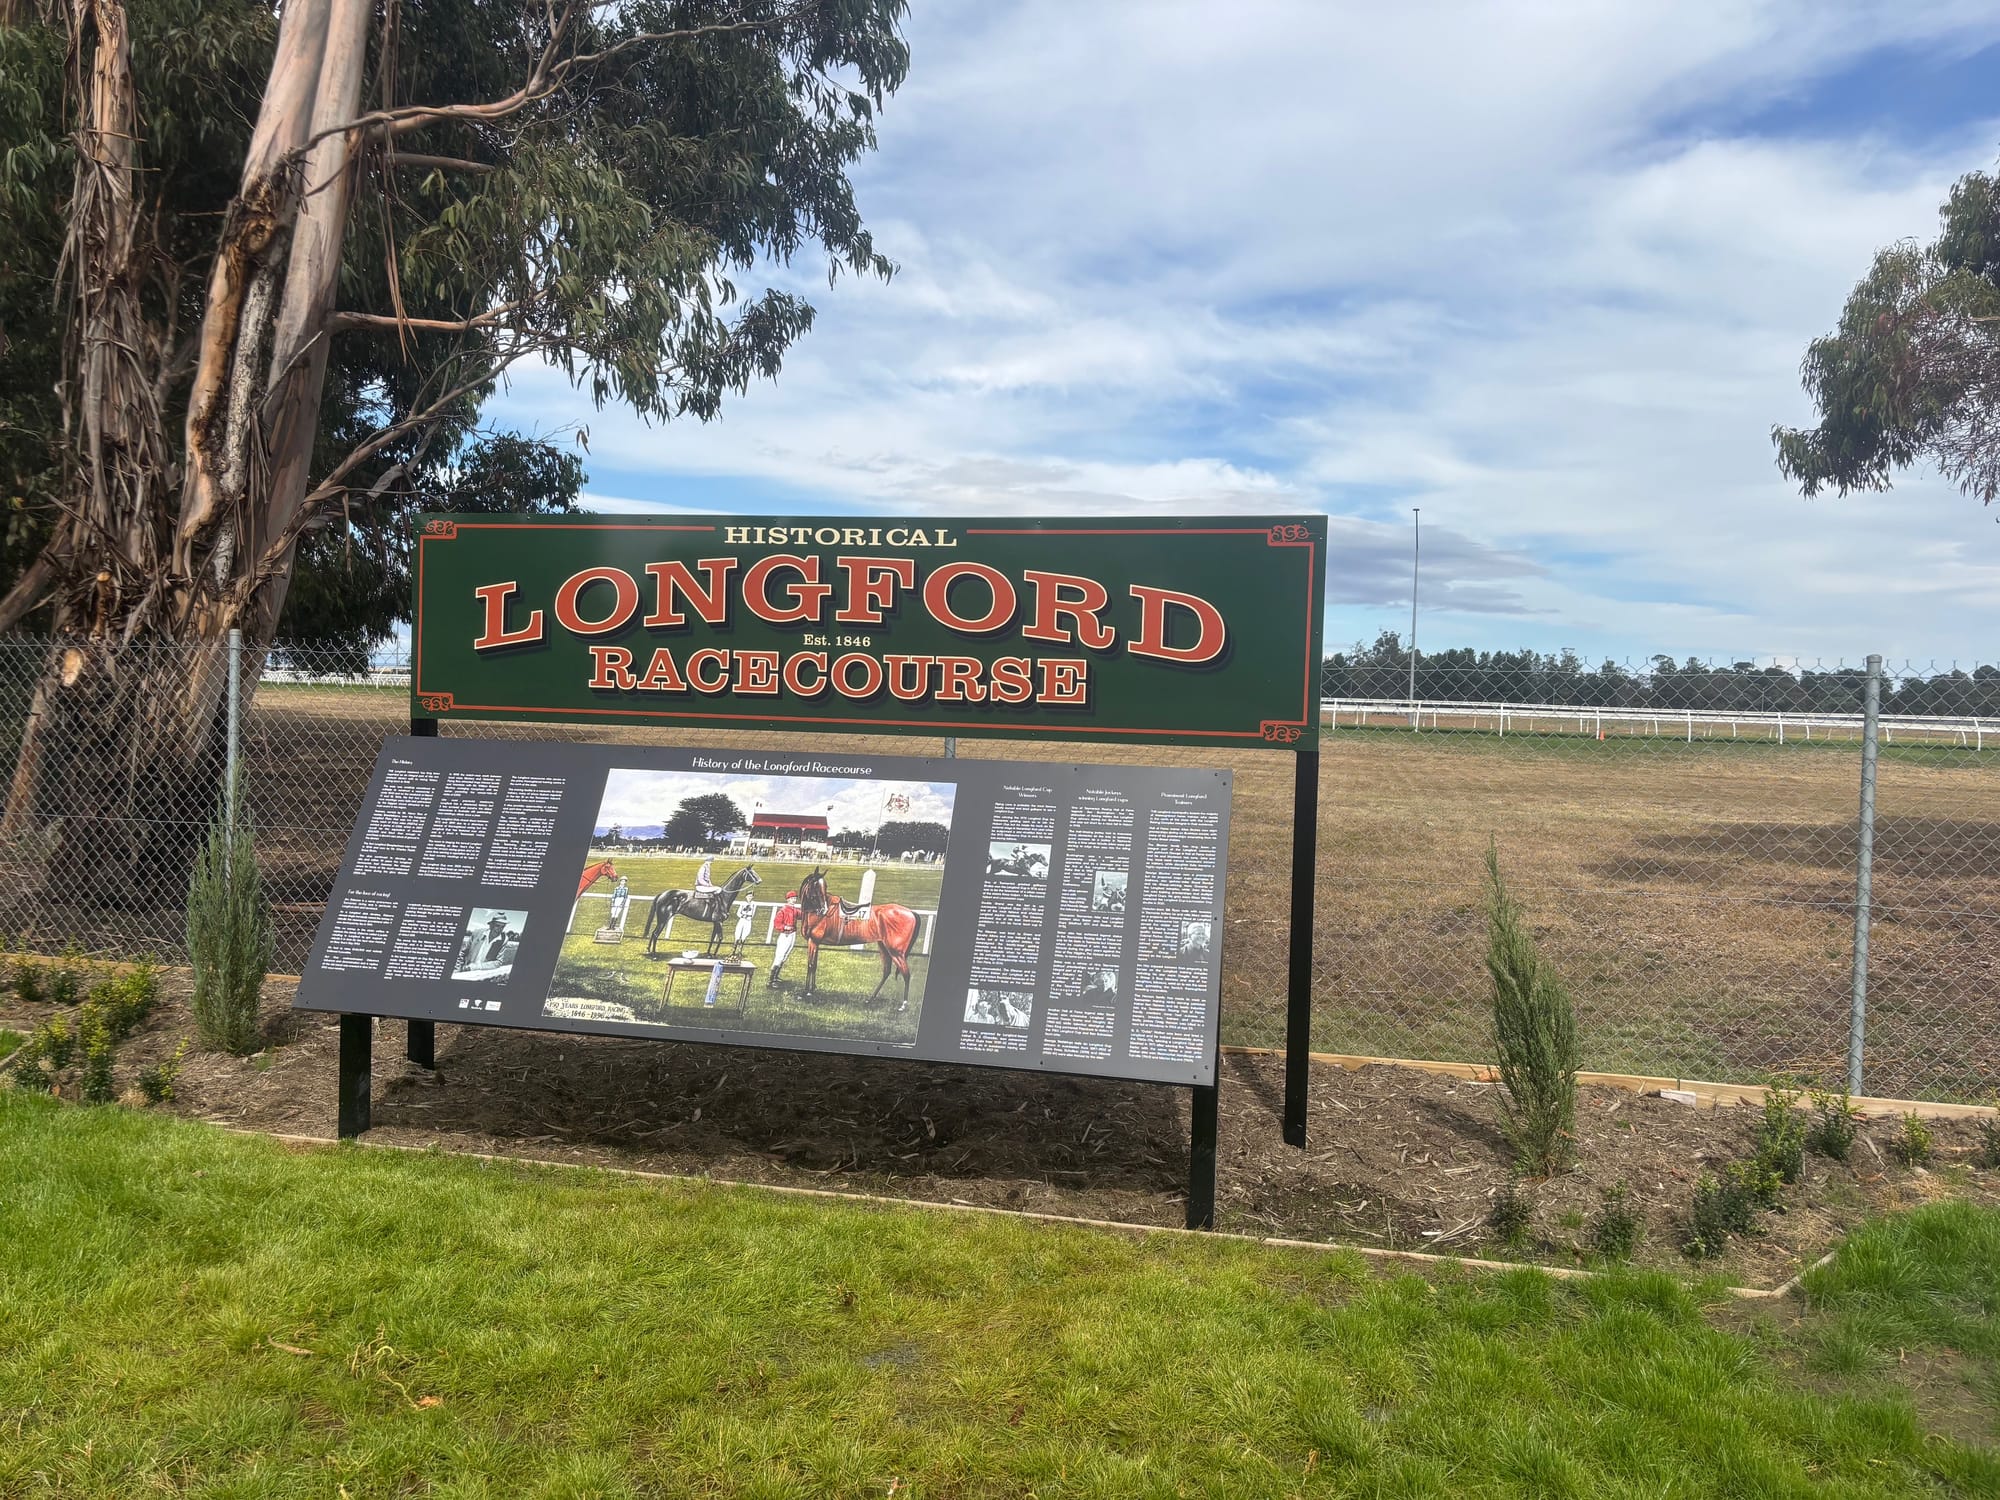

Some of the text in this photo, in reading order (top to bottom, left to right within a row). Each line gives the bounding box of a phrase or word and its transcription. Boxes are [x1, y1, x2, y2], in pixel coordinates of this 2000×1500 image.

[724, 526, 958, 547] HISTORICAL
[473, 554, 1227, 664] LONGFORD
[803, 633, 871, 648] Est. 1846
[588, 645, 1088, 706] RACECOURSE
[692, 756, 873, 775] History of the Longford Racecourse
[858, 910, 867, 919] 17
